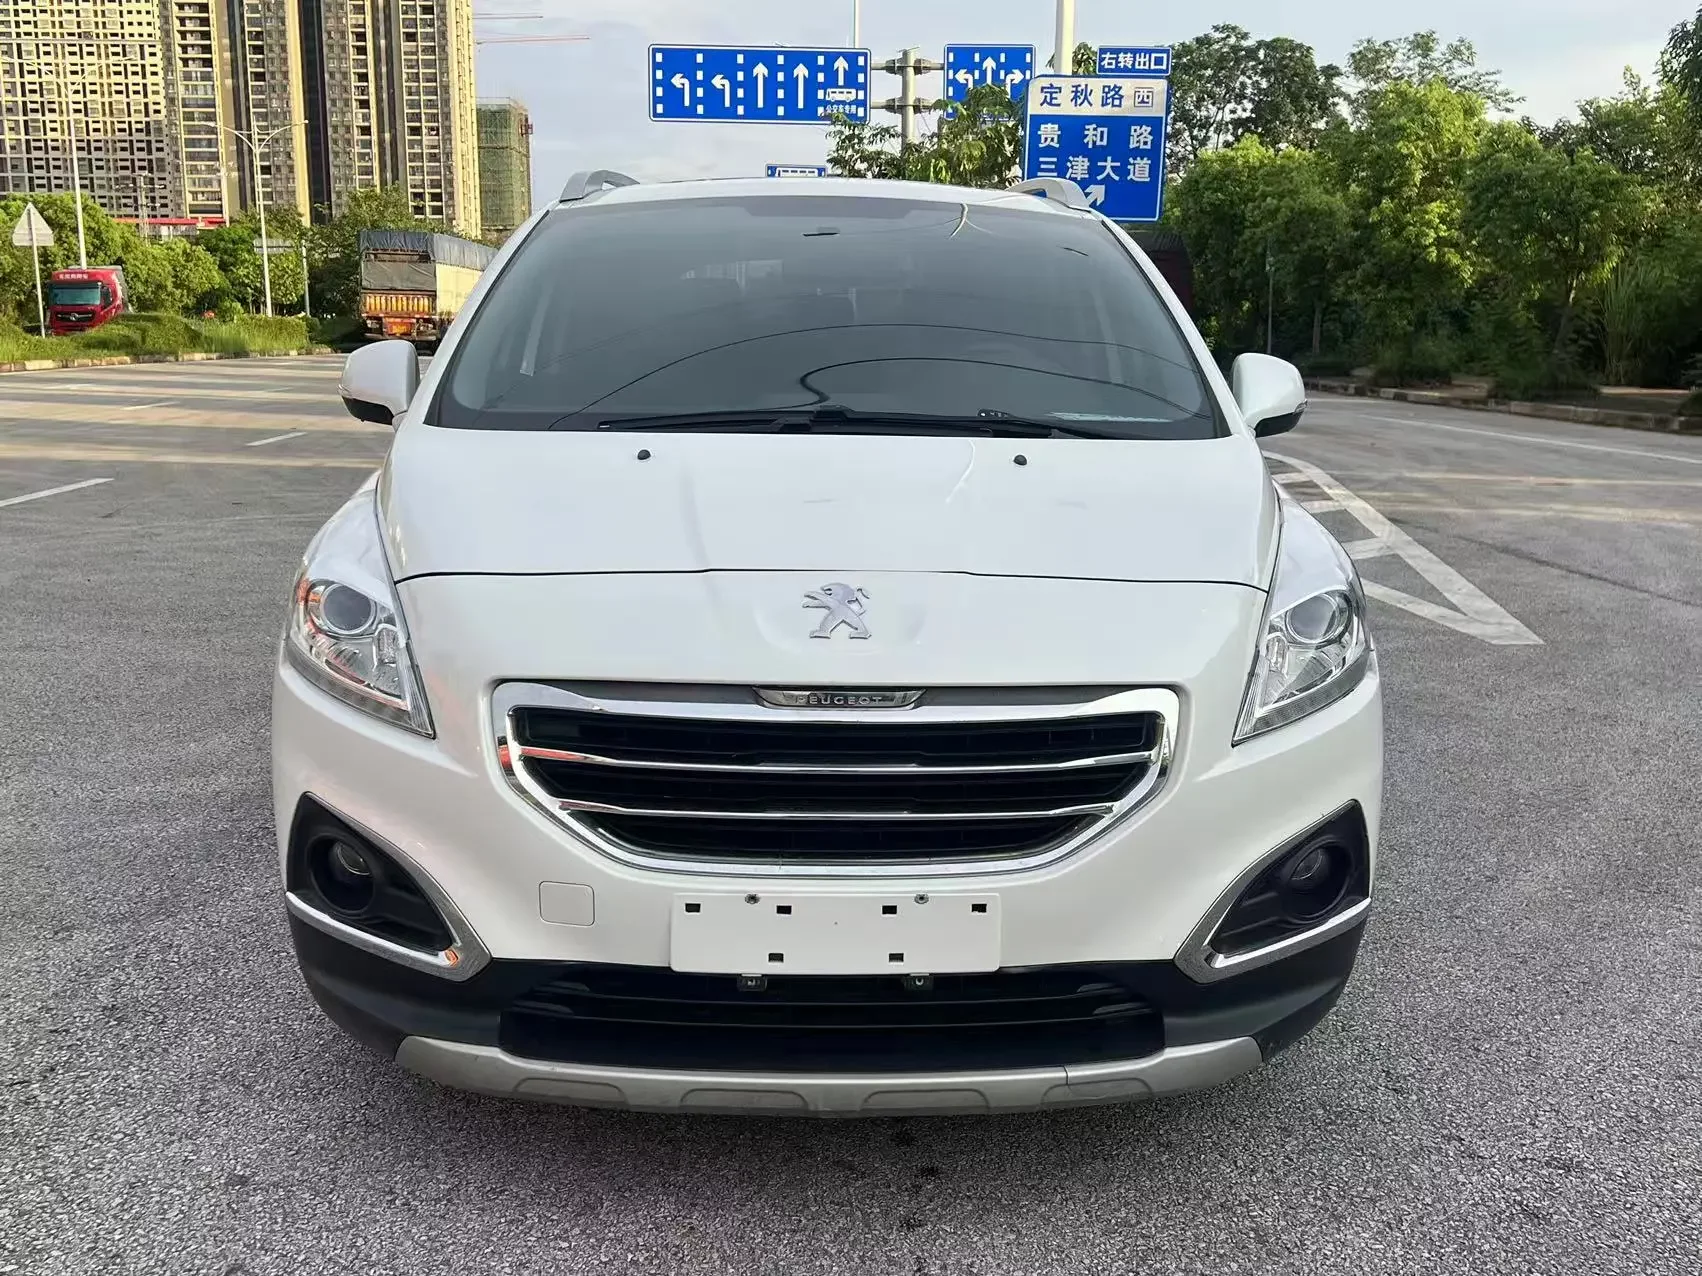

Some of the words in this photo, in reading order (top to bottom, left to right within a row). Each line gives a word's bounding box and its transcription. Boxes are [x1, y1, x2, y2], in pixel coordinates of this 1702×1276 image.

[1101, 52, 1167, 70] 右转出口
[1040, 83, 1125, 107] 定秋路
[1134, 87, 1154, 107] 西
[1037, 123, 1153, 149] 贵和路
[1037, 155, 1151, 182] 三津大道
[796, 696, 883, 705] PEUGEOT
